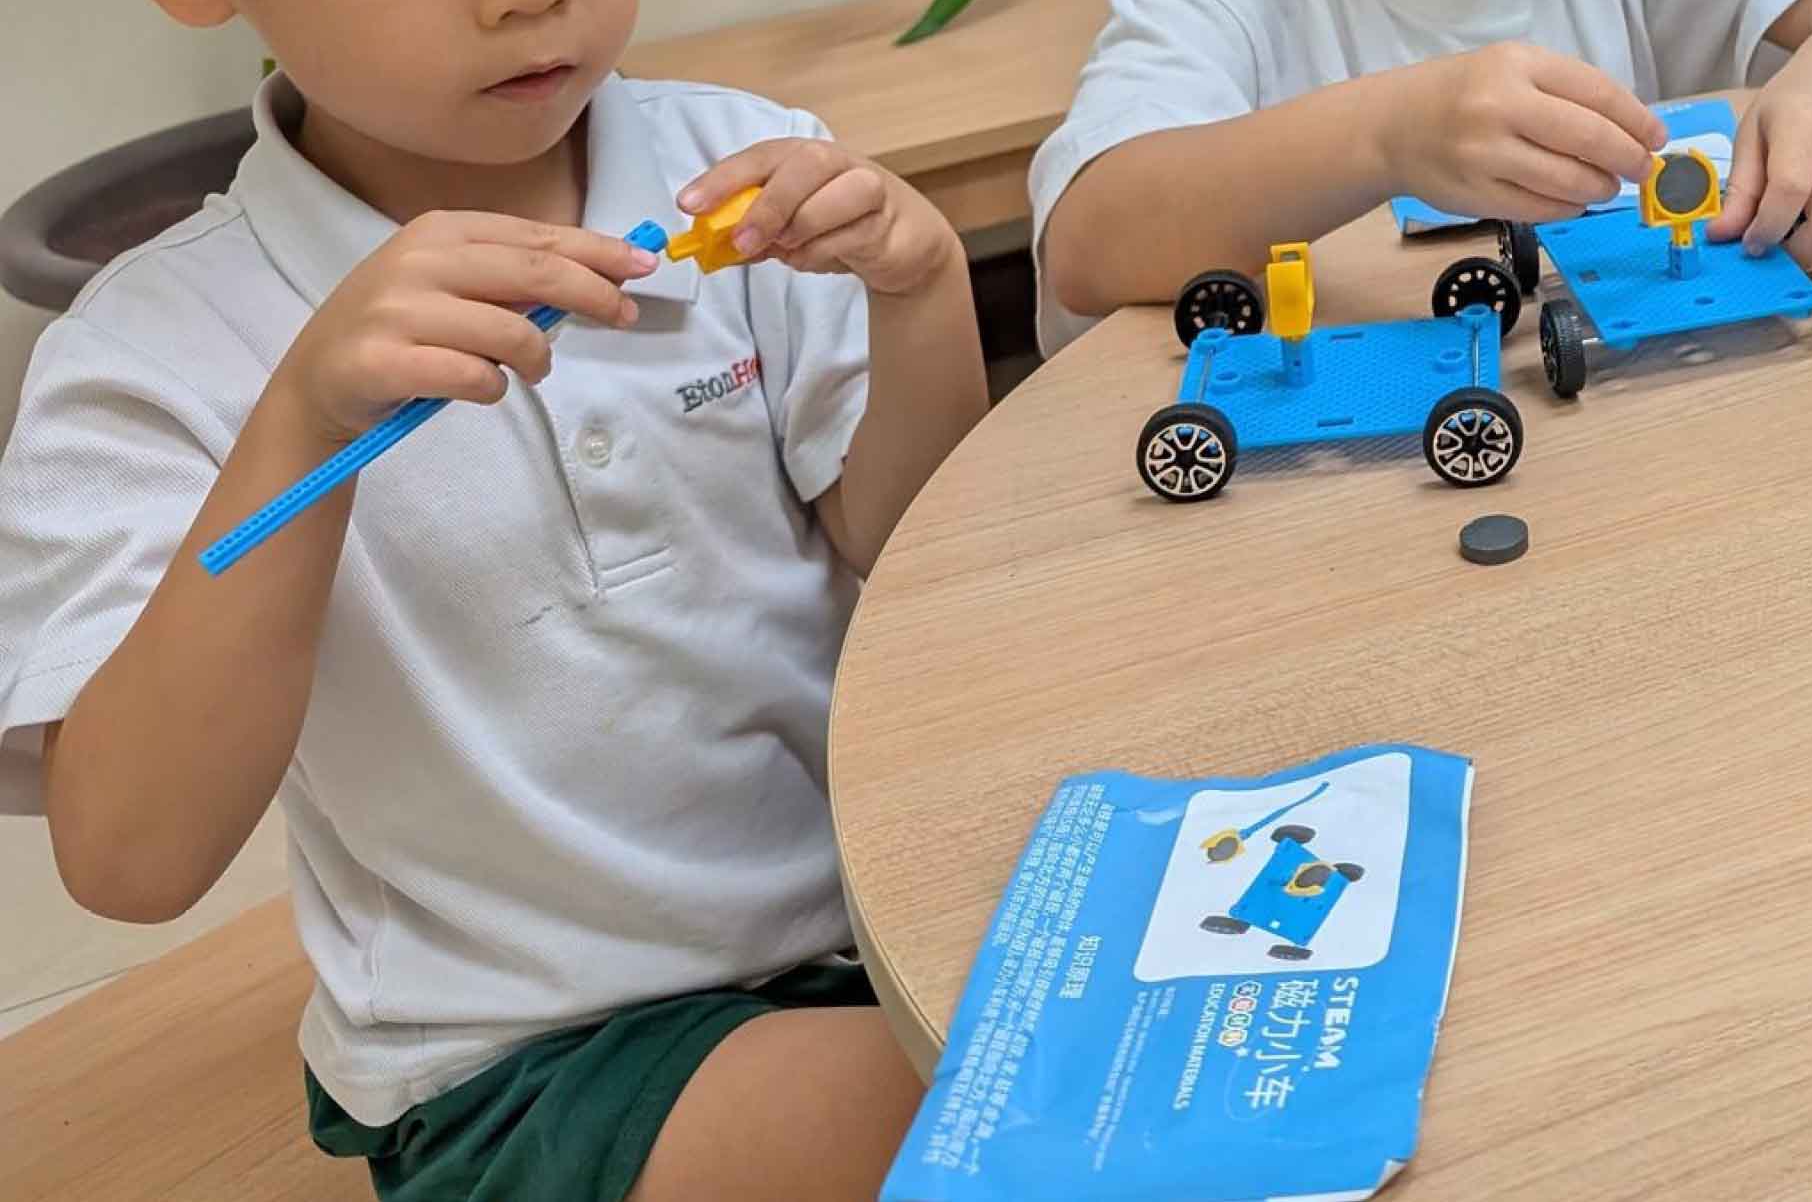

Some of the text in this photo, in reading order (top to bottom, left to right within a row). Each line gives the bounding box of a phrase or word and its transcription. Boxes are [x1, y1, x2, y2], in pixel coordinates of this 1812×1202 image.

[1245, 979, 1321, 1109] 磁力小车
[1314, 976, 1360, 1069] STEAM
